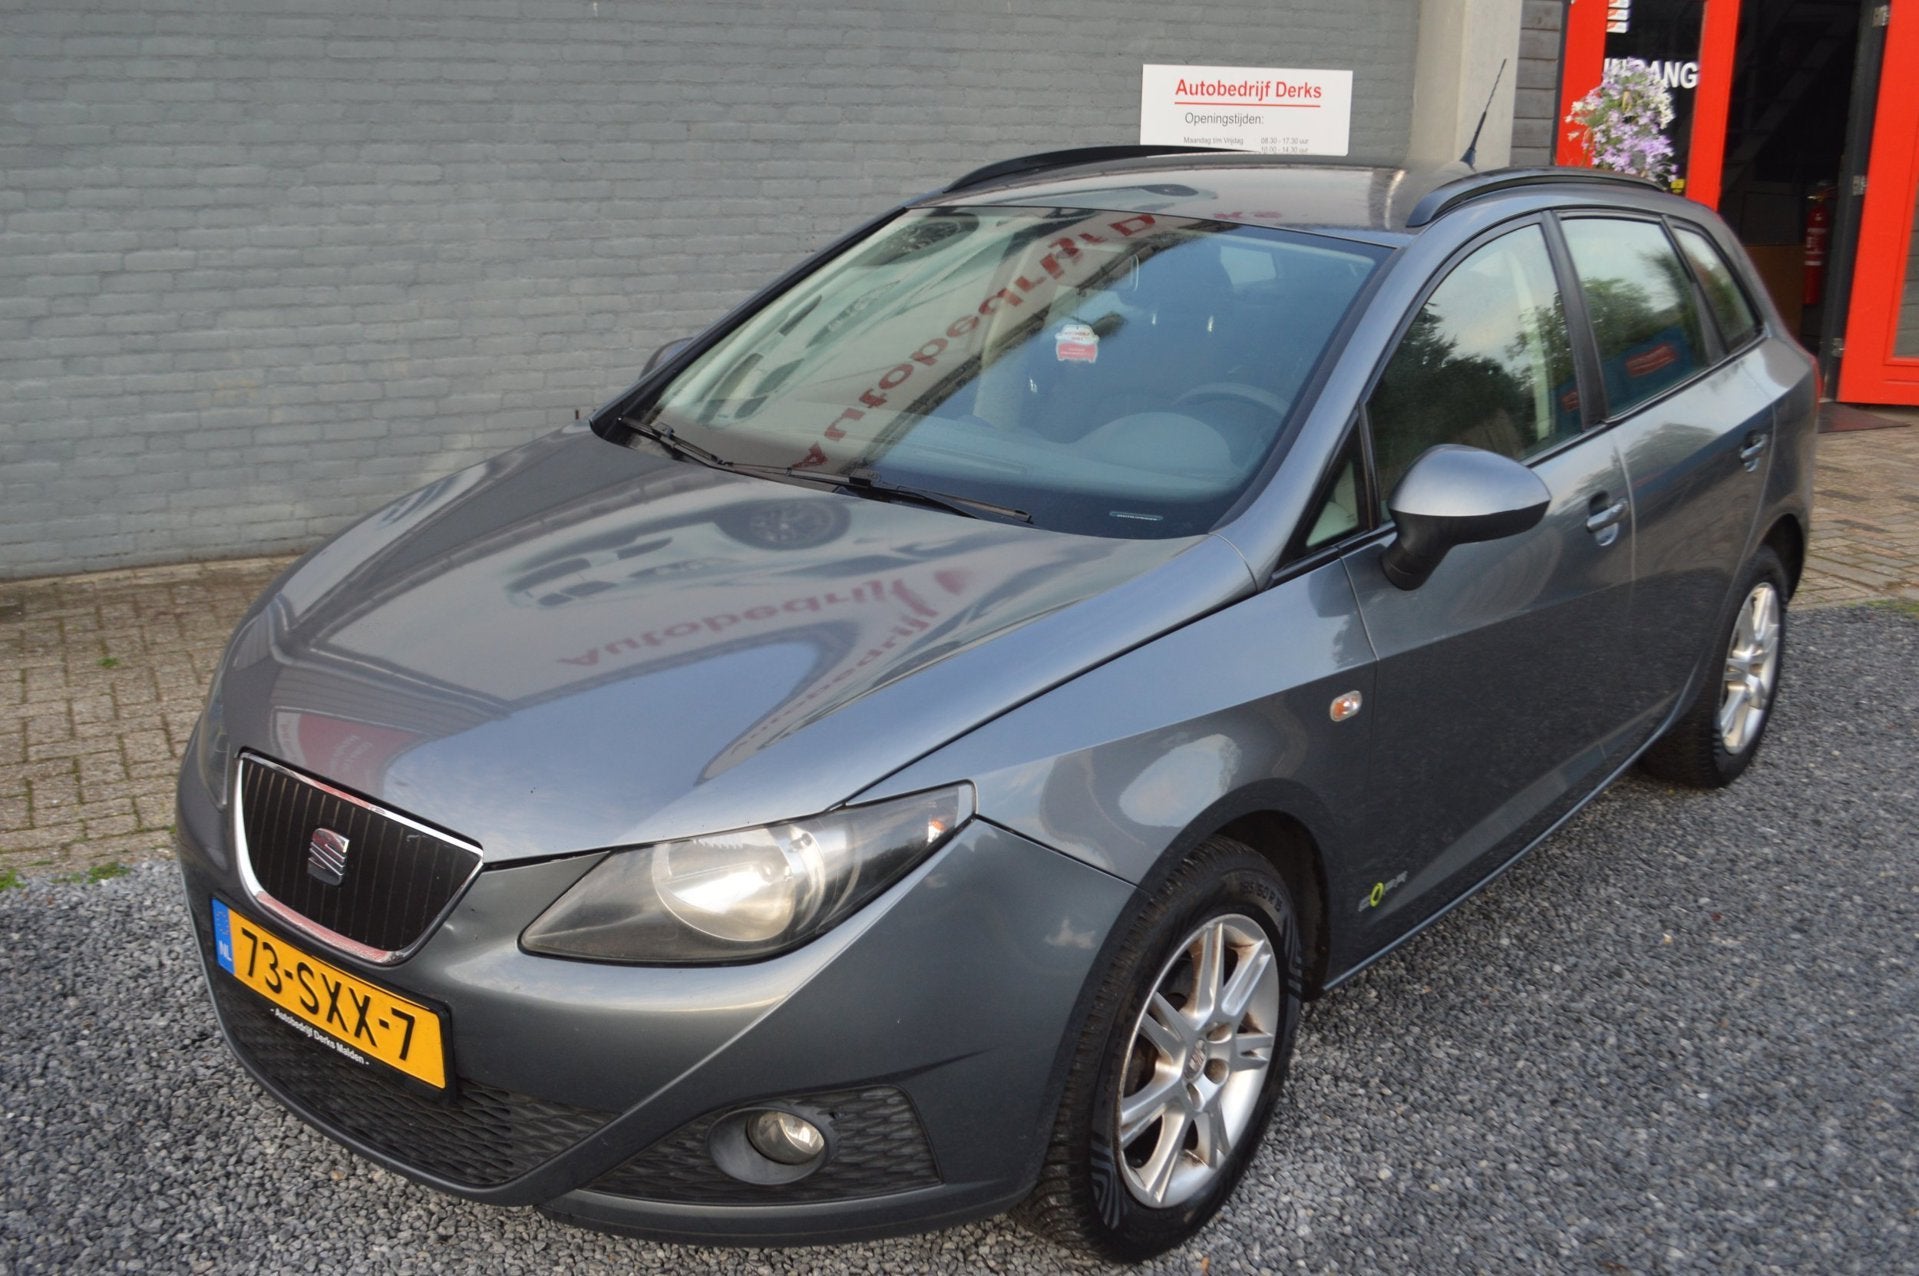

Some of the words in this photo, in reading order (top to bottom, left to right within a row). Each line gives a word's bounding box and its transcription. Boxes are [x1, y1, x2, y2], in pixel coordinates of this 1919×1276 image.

[1175, 78, 1271, 101] Autobedrijf
[1275, 81, 1322, 99] Derks
[1184, 112, 1264, 126] Openingstijden:
[1183, 136, 1212, 145] Maandag
[1223, 136, 1244, 145] Vrijdag
[218, 940, 233, 962] NL
[241, 927, 416, 1062] 73-SXX-7
[313, 1029, 336, 1050] Derks
